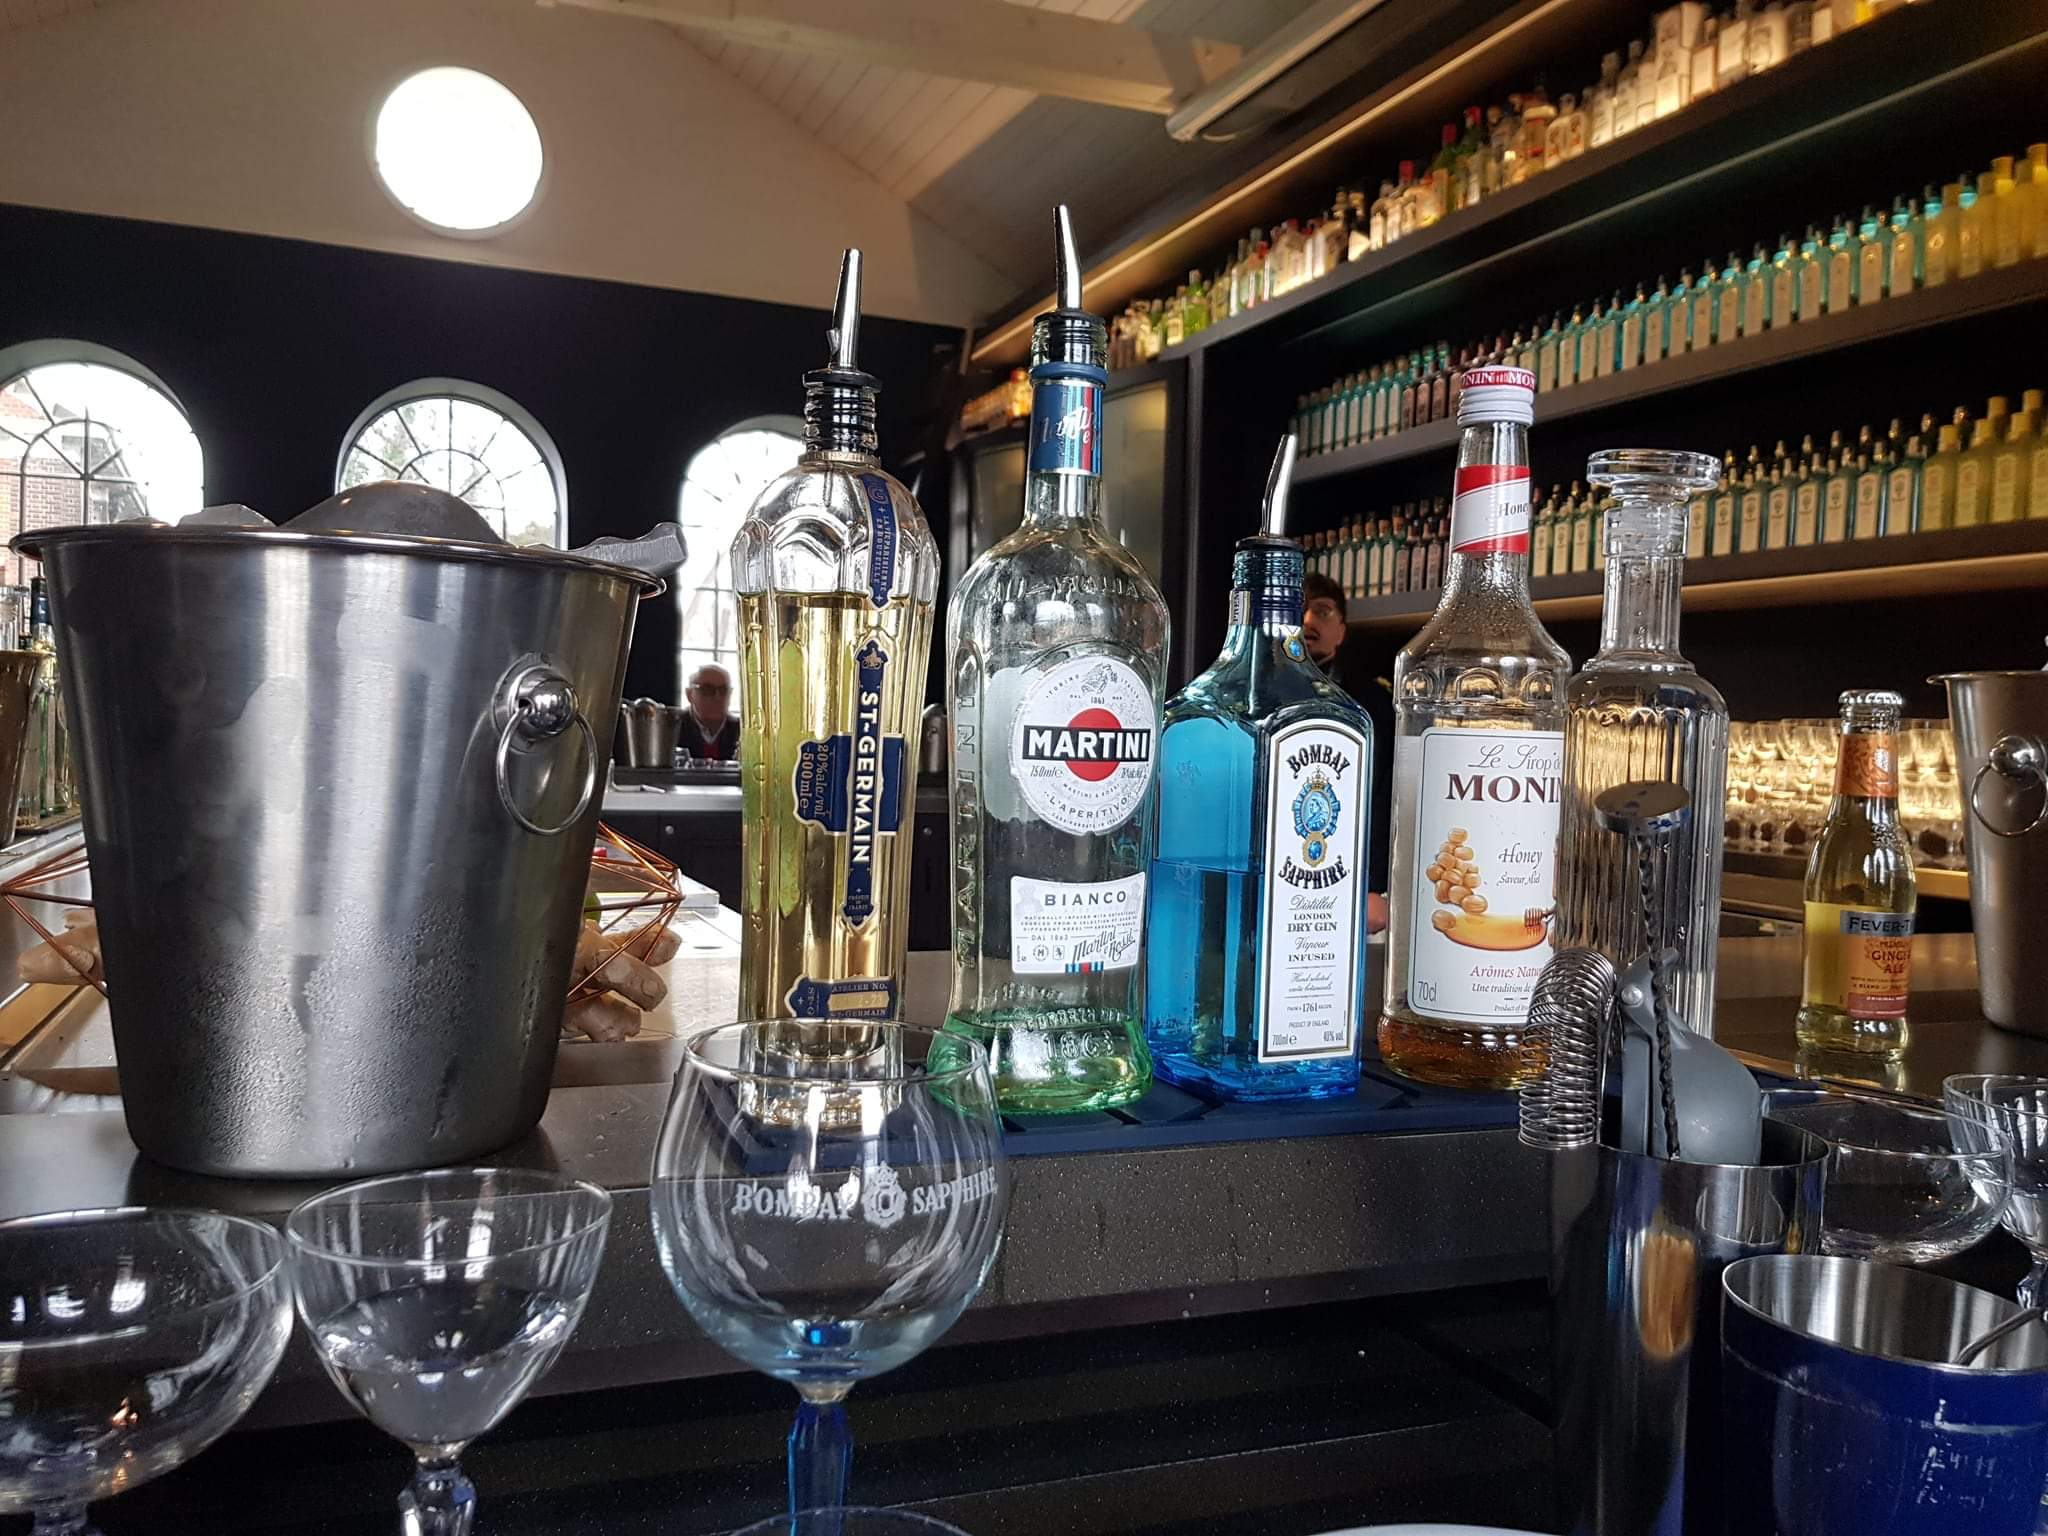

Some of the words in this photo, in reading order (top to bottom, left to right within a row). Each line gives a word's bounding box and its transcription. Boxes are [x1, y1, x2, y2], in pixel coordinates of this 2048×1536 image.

[1499, 502, 1529, 516] Hone
[1028, 728, 1148, 759] MARTINI
[1286, 744, 1351, 780] BOMBAY
[1468, 744, 1505, 769] Le
[1508, 744, 1552, 777] Sirop
[1498, 842, 1543, 870] Honey
[1278, 855, 1348, 890] SAPPHIRE
[1044, 891, 1126, 906] BIANCO
[1288, 895, 1338, 911] Distilled
[1294, 913, 1332, 921] LONDON
[1287, 923, 1313, 933] DRY
[1314, 921, 1338, 932] GIN
[1288, 952, 1336, 962] INFUSED
[1470, 964, 1515, 978] Arômes
[1418, 980, 1438, 1002] 70cl
[1471, 983, 1490, 993] Une
[1491, 982, 1523, 993] tradition
[1302, 1002, 1318, 1012] 1761
[732, 1182, 854, 1223] BOMBAY
[912, 1167, 999, 1215] SAPPHIRE
